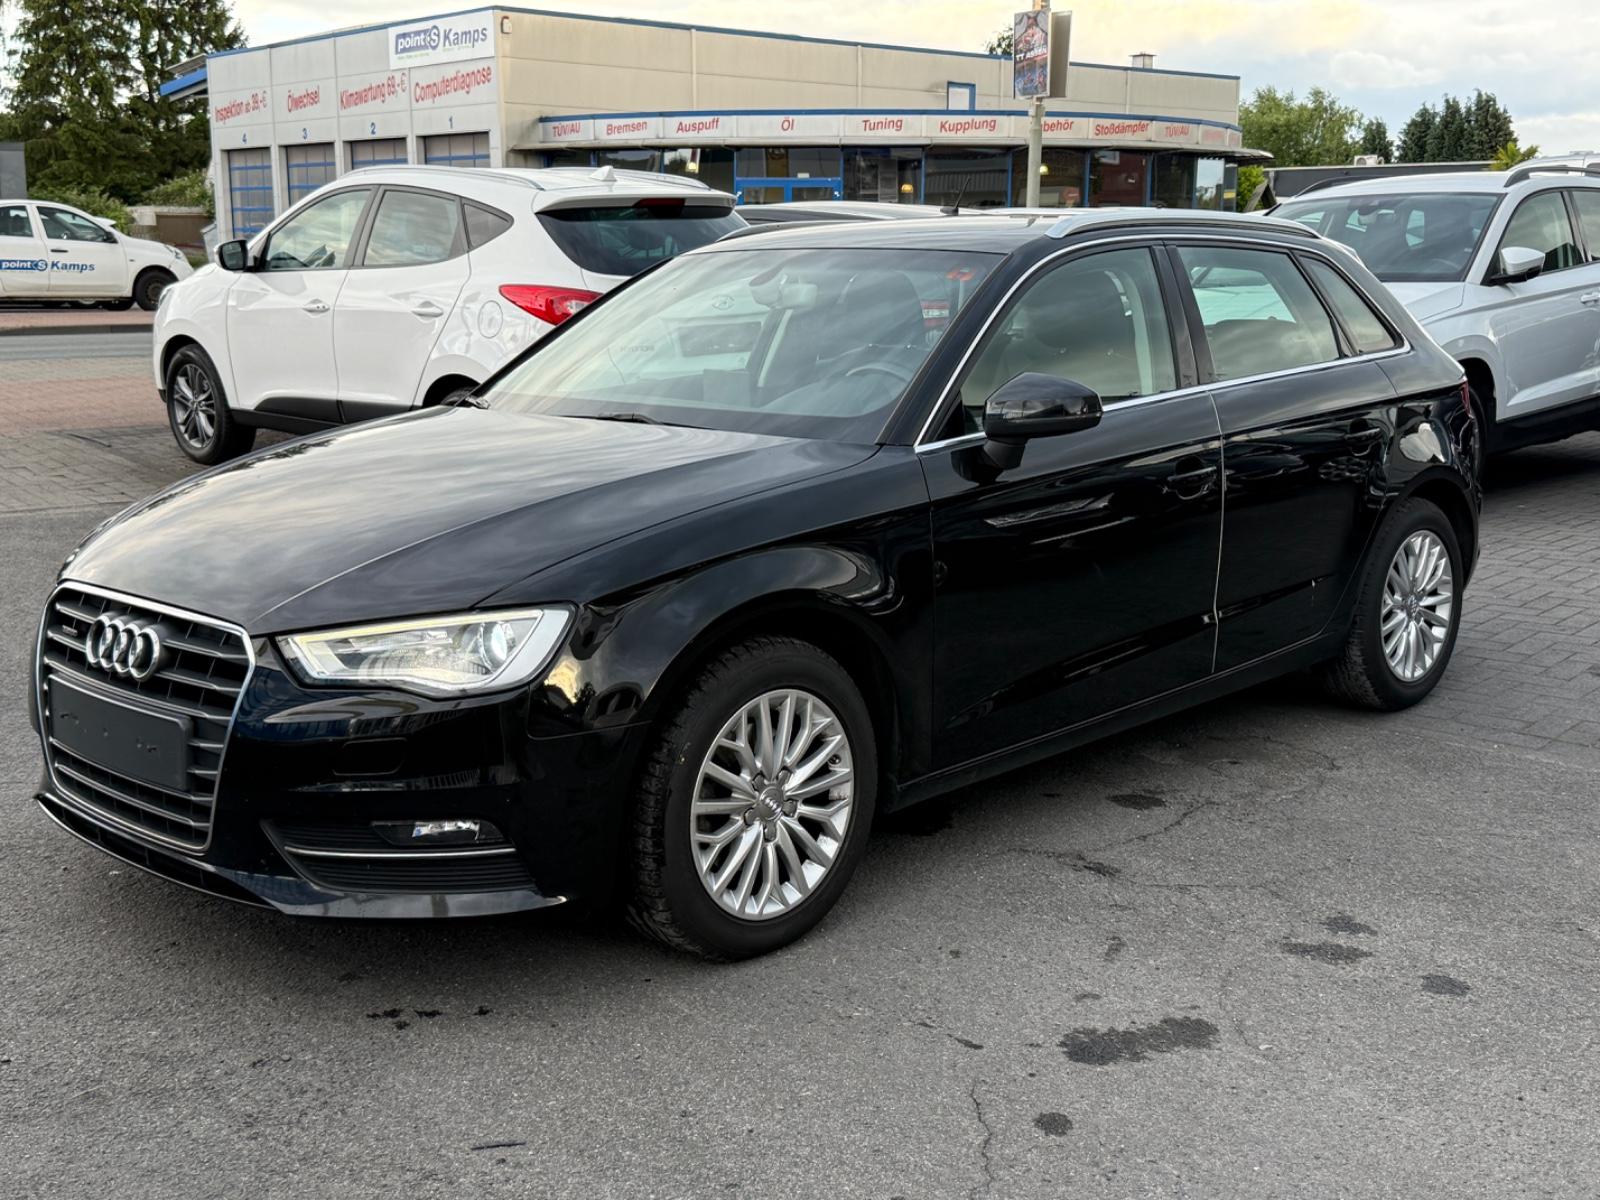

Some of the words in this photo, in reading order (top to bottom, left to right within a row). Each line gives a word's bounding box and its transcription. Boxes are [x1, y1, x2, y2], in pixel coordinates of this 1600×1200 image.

[442, 27, 488, 49] Kamps
[413, 66, 492, 104] Computerdiagnose
[287, 85, 320, 112] Ölwechsel
[340, 82, 386, 110] Klimawartung
[370, 122, 376, 135] 2
[606, 120, 648, 136] Bremsen
[676, 118, 720, 134] Auspuff
[781, 117, 794, 131] Öl
[862, 119, 904, 132] Tuning
[939, 119, 997, 134] Kupplung
[1039, 119, 1074, 132] behör
[1094, 122, 1150, 137] Stoßdämpfer
[242, 133, 247, 144] 4
[302, 127, 308, 139] 3
[1, 260, 32, 270] point
[51, 260, 96, 273] Kamps
